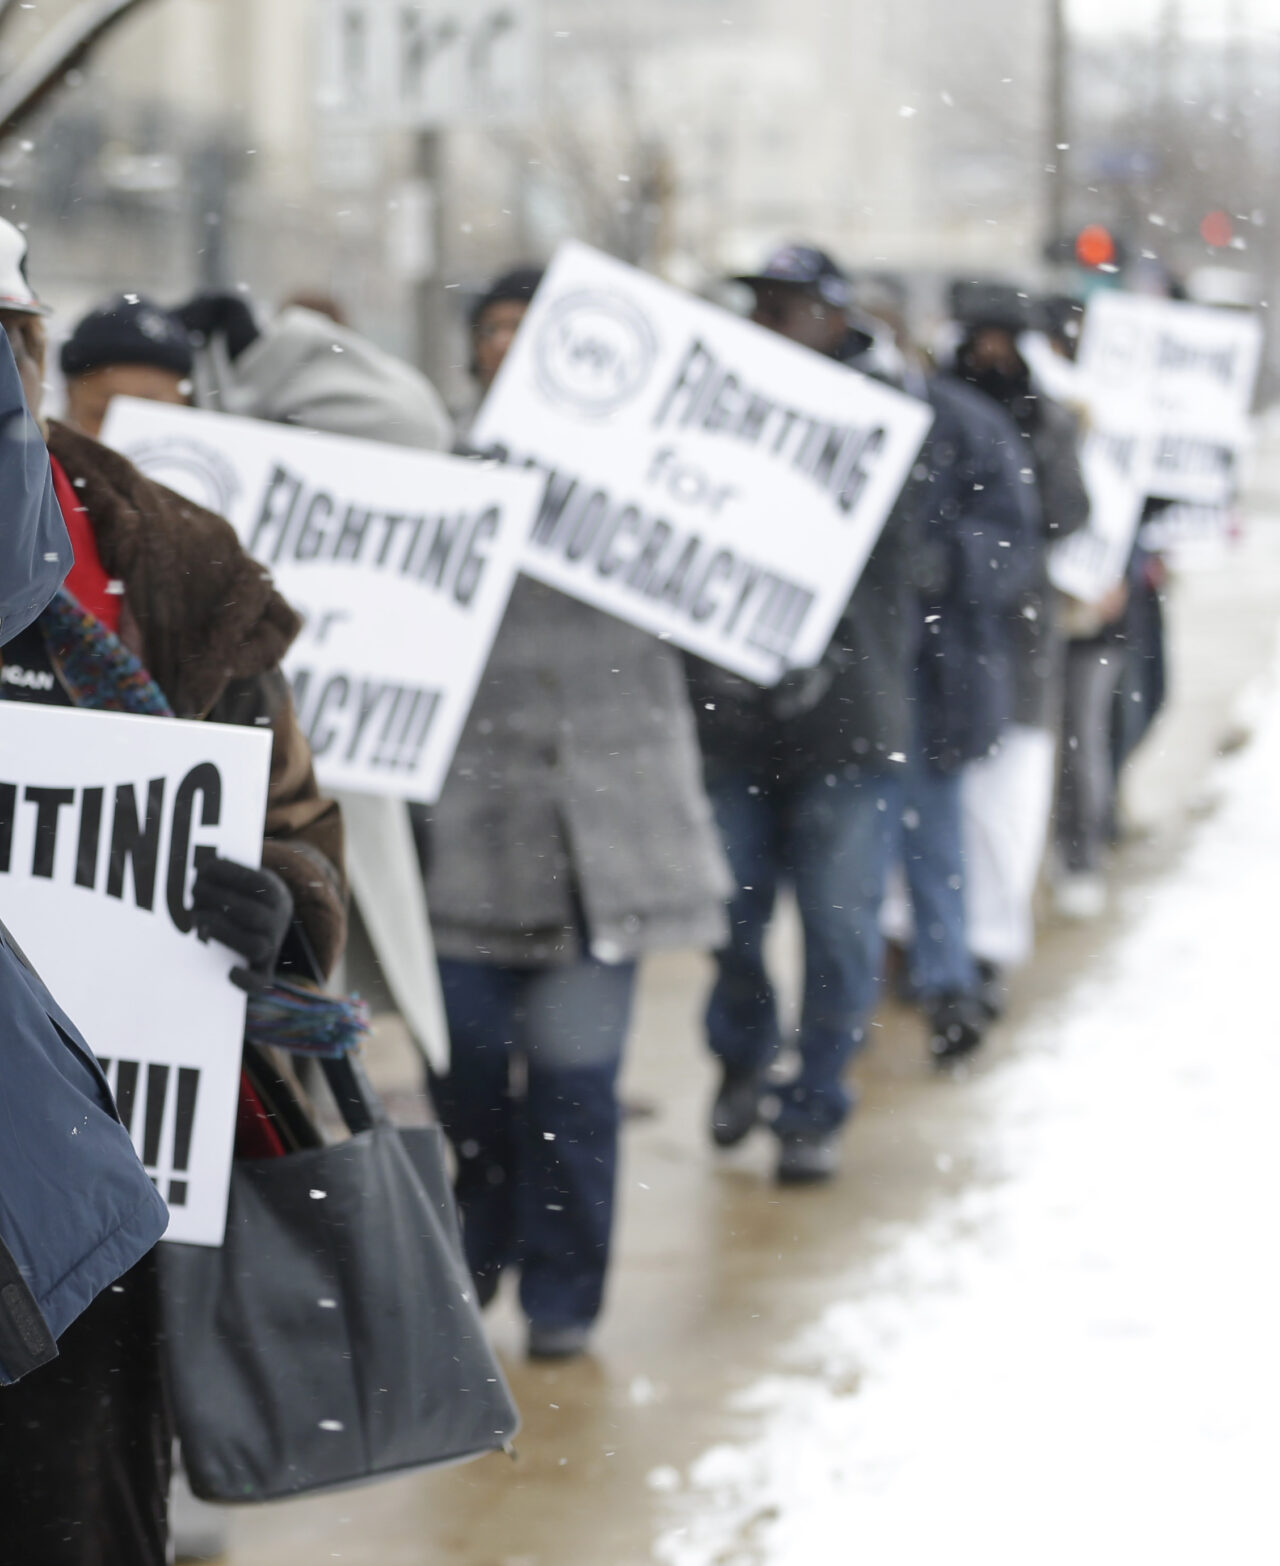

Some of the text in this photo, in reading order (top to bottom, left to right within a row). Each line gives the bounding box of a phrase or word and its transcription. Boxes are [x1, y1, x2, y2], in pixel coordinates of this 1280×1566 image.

[648, 445, 740, 513] for
[653, 337, 885, 513] FIGHTING
[250, 466, 500, 606] FIGHTING
[526, 459, 817, 657] MOCRACY!!!
